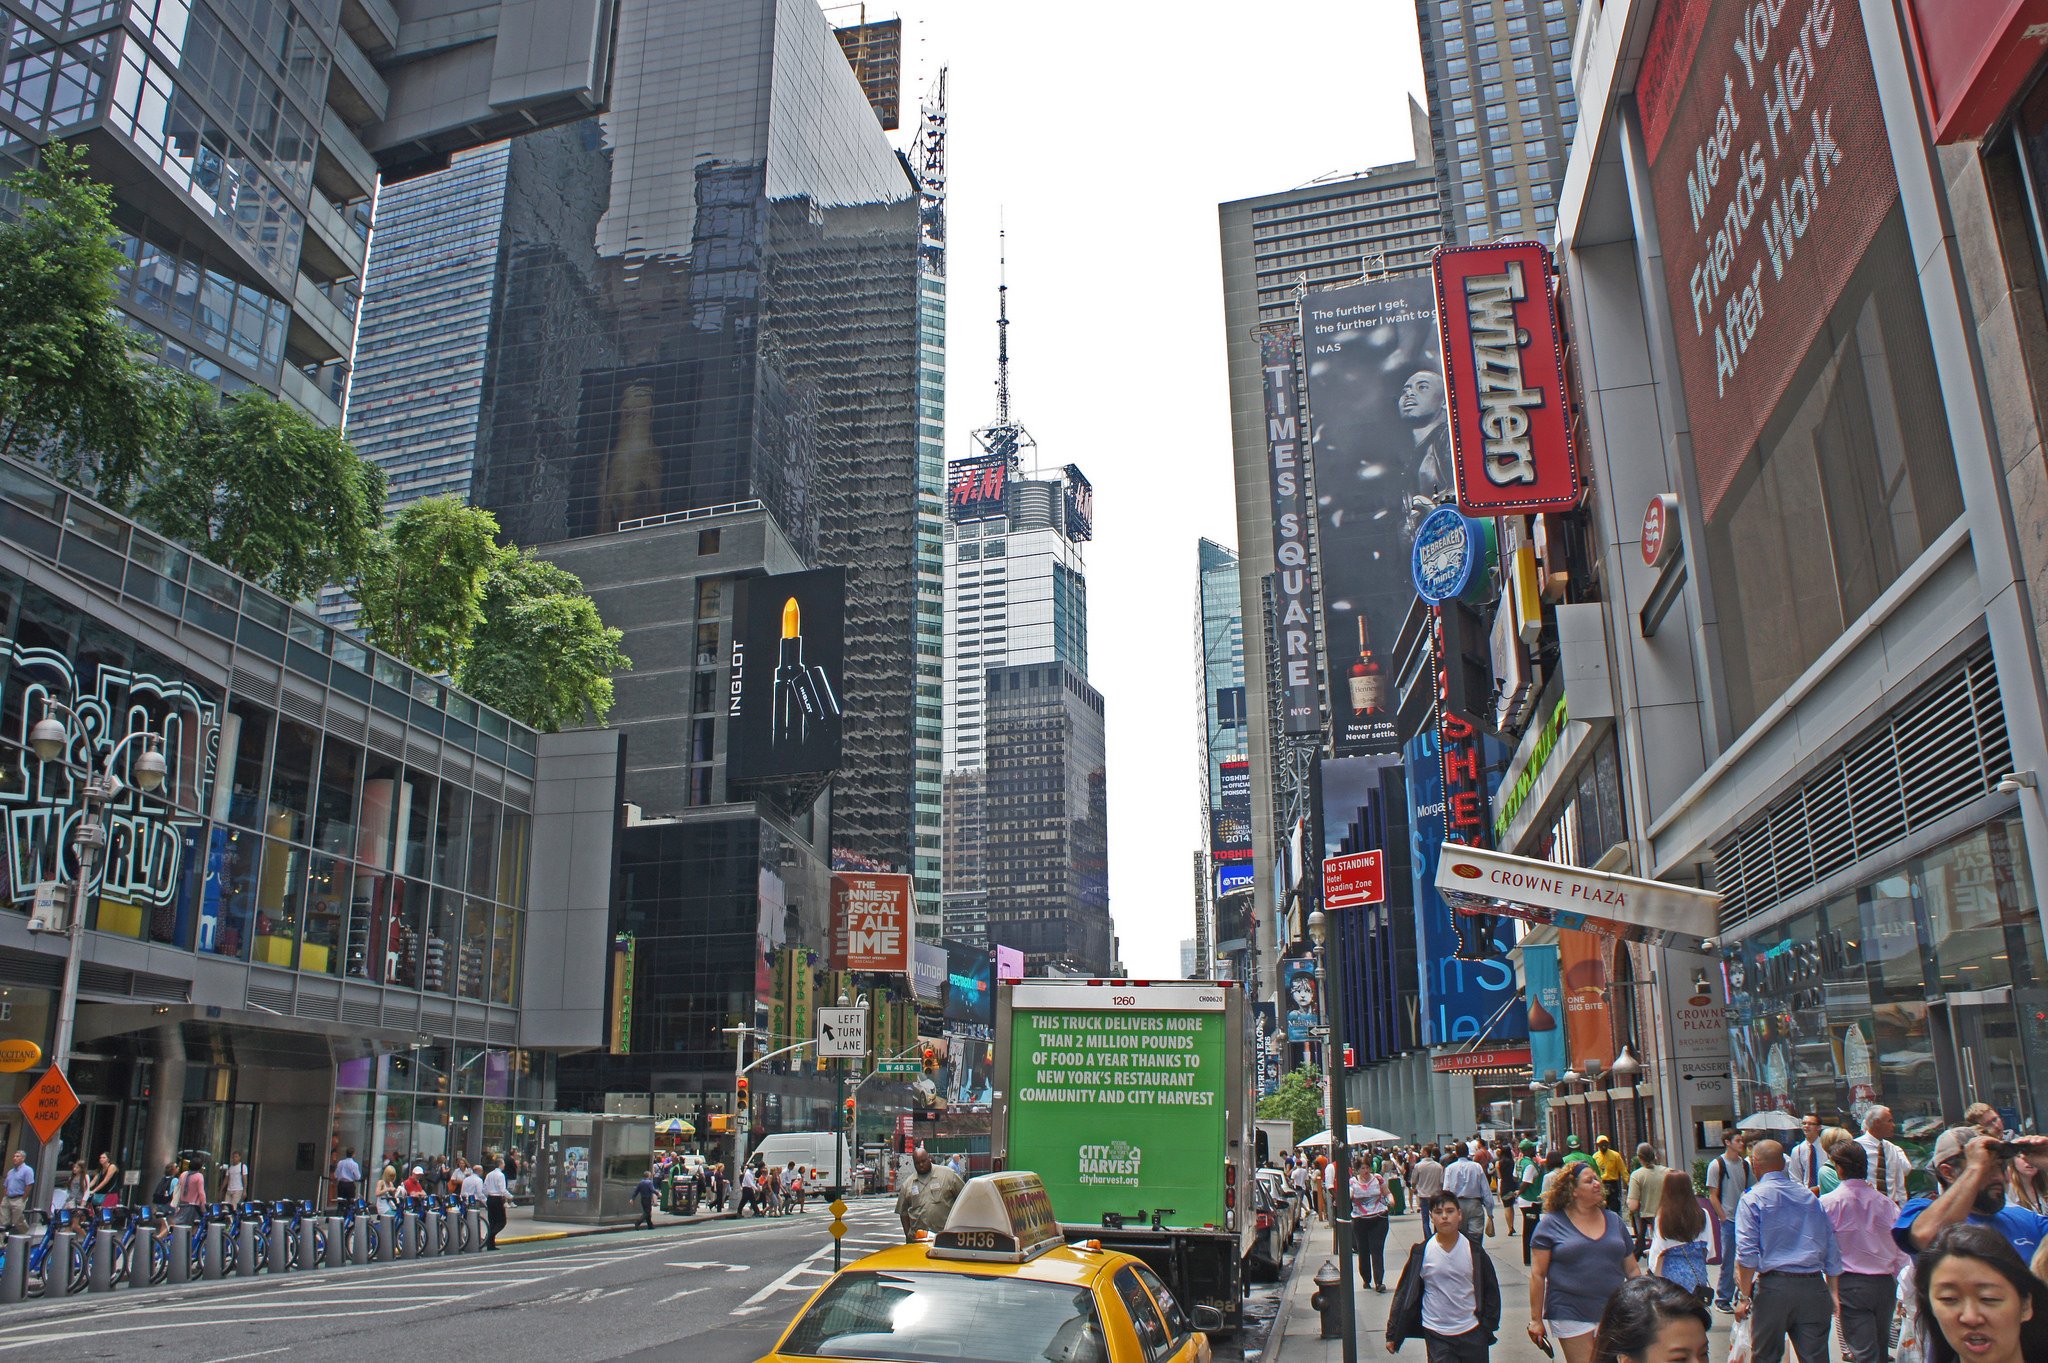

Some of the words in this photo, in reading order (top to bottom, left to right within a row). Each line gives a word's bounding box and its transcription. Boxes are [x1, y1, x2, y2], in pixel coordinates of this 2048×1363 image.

[1687, 72, 1740, 233] Meet
[1690, 141, 1766, 336] Friends
[1764, 0, 1835, 159] Here
[1714, 259, 1765, 399] After
[1763, 104, 1843, 283] Work
[1312, 309, 1333, 321] The
[1336, 303, 1377, 317] further
[1379, 302, 1383, 311] I
[1385, 299, 1408, 313] get,
[1315, 324, 1334, 334] the
[1336, 317, 1377, 332] further
[1380, 315, 1383, 325] I
[1387, 311, 1415, 324] want
[1417, 309, 1430, 320] to
[1316, 343, 1341, 354] NAS
[1465, 260, 1542, 485] Twizzlers
[1266, 365, 1296, 497] TIMES
[952, 465, 1006, 505] H&M
[1278, 513, 1309, 687] SQUARE
[730, 640, 744, 717] INGLOT
[799, 686, 813, 713] INGLOT
[1290, 706, 1311, 716] NYC
[1348, 723, 1372, 731] Never
[1374, 721, 1395, 730] stop.
[1346, 732, 1370, 740] Never
[1371, 730, 1398, 739] settle.
[1276, 697, 1289, 792] AMERICAN
[1225, 834, 1250, 844] 2014
[5, 806, 182, 905] WORLD
[1213, 849, 1254, 860] TOSHIB
[1326, 862, 1337, 873] NO
[1338, 856, 1375, 871] STANDING
[1229, 875, 1254, 886] TDK
[1326, 875, 1342, 884] Hotel
[1326, 881, 1354, 893] Loading
[1355, 879, 1373, 888] Zone
[1491, 868, 1564, 895] CROWNE
[1571, 883, 1627, 907] PLAZA
[849, 890, 900, 902] NNIEST
[861, 915, 900, 931] ALL
[914, 961, 944, 981] YUNDAI
[1112, 996, 1136, 1006] 1260
[1567, 996, 1585, 1004] ONE
[1568, 1003, 1583, 1011] BIG
[1584, 1003, 1603, 1011] BITE
[838, 1014, 861, 1024] LEFT
[1676, 1008, 1726, 1020] CROWNE
[1032, 1015, 1060, 1029] THIS
[1062, 1016, 1102, 1030] TRUCK
[1105, 1016, 1164, 1031] DELIVERS
[1166, 1017, 1203, 1031] MORE
[1684, 1020, 1721, 1030] PLAZA
[838, 1028, 861, 1037] TURN
[836, 1041, 861, 1050] LANE
[1039, 1034, 1072, 1048] THAN
[1076, 1035, 1082, 1048] 2
[1086, 1035, 1138, 1049] MILLION
[1141, 1035, 1194, 1050] POUNDS
[1032, 1052, 1048, 1066] OF
[1051, 1052, 1083, 1066] FOOD
[1086, 1053, 1095, 1066] A
[1097, 1053, 1129, 1067] YEAR
[1131, 1053, 1180, 1068] THANKS
[1184, 1054, 1200, 1068] TO
[1456, 1054, 1495, 1065] WORLD
[1682, 1061, 1730, 1073] BRASSERIE
[1037, 1070, 1065, 1084] NEW
[1067, 1070, 1112, 1085] YORK'S
[1114, 1071, 1195, 1086] RESTAURANT
[1257, 1052, 1266, 1101] AMERICAN
[41, 1085, 60, 1095] ROAD
[1696, 1080, 1722, 1092] 1605
[38, 1099, 59, 1108] WORK
[1020, 1088, 1096, 1103] COMMUNITY
[1098, 1089, 1125, 1104] AND
[1127, 1089, 1155, 1104] CITY
[1157, 1090, 1214, 1106] HARVEST
[35, 1111, 60, 1120] AHEAD
[655, 1112, 700, 1121] INGLOT
[1079, 1144, 1110, 1160] CITY
[1079, 1160, 1140, 1174] HARVEST
[1079, 1174, 1139, 1187] cityharvest.org
[957, 1232, 995, 1248] 9H36
